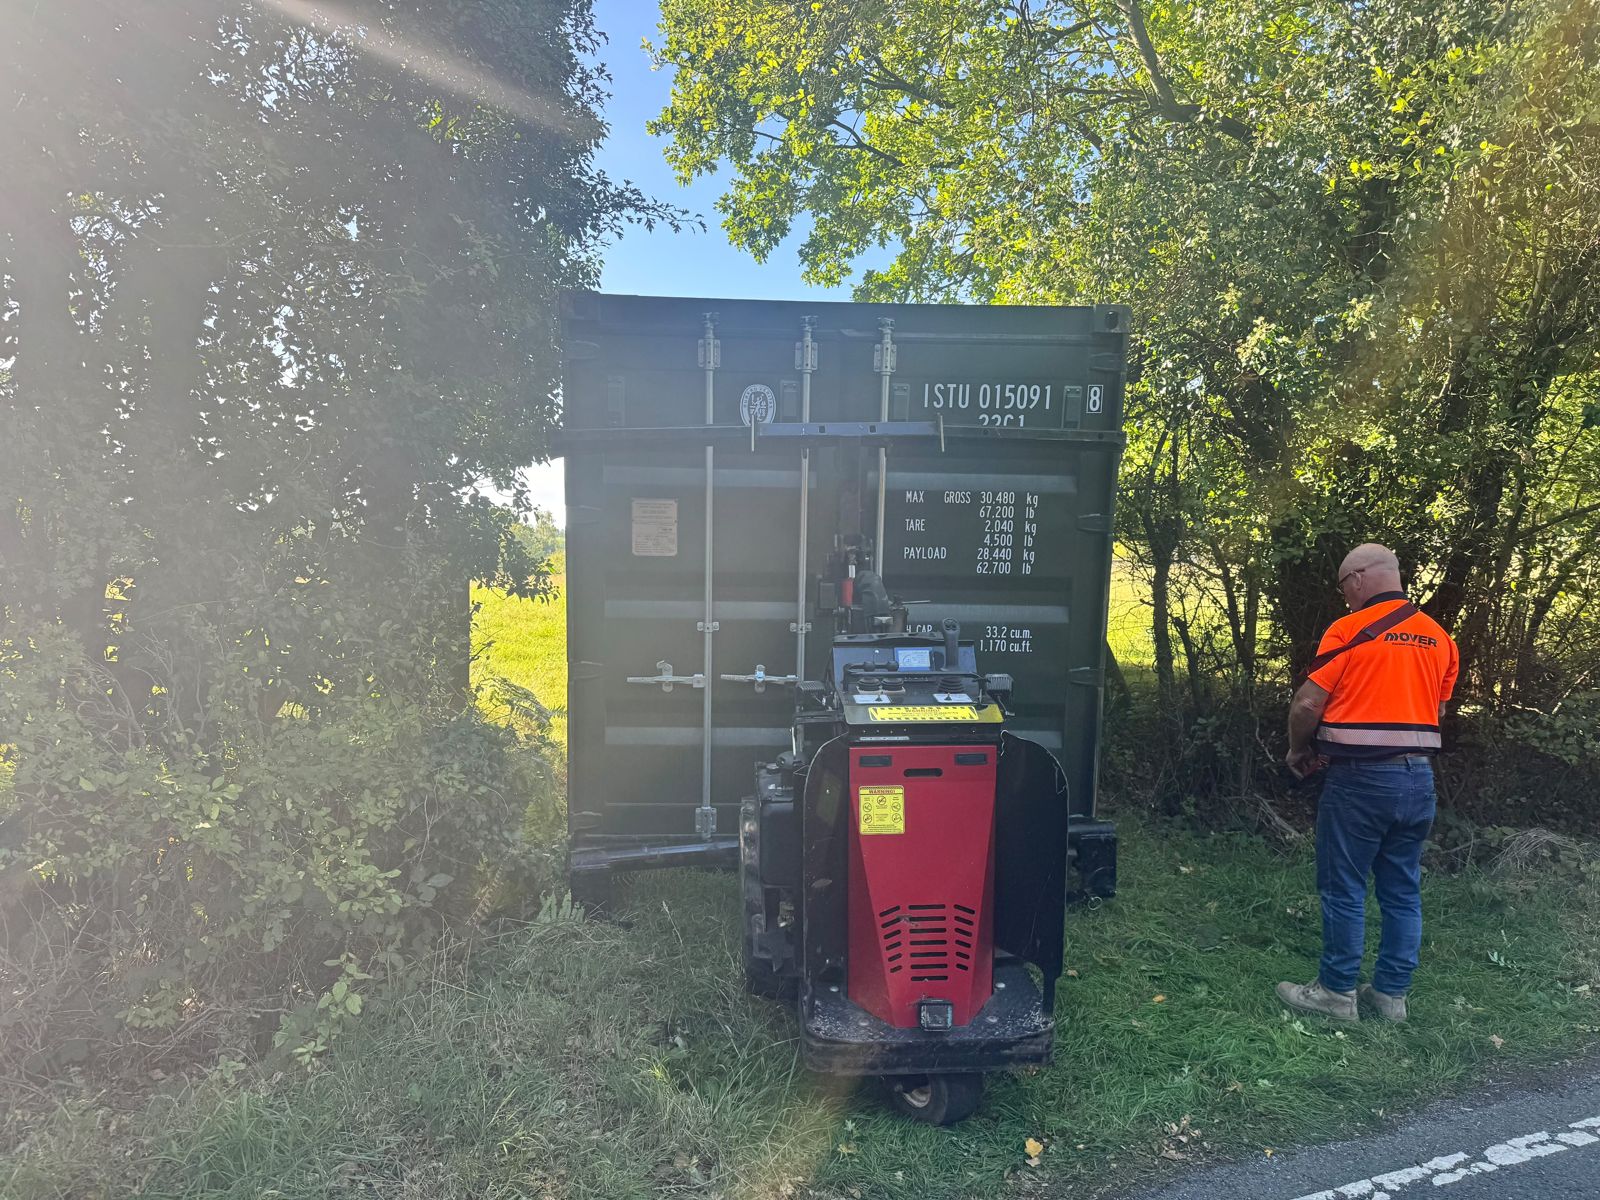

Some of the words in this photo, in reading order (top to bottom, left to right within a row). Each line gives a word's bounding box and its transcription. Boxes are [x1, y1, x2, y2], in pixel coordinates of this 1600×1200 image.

[924, 383, 970, 409] ISTU
[979, 384, 1051, 410] 015091
[1089, 386, 1101, 411] 8
[905, 490, 925, 503] MAX
[944, 491, 971, 504] GROSS
[1026, 492, 1039, 508] kg
[1025, 506, 1035, 519] lb
[905, 518, 926, 531] TARE
[1024, 521, 1037, 536] kg
[1023, 535, 1033, 547] lb
[903, 546, 947, 560] PAYLOAD
[1022, 549, 1035, 564] kg
[1022, 562, 1031, 575] lb
[985, 625, 1007, 638] 33.2
[1384, 632, 1438, 648] MOVER
